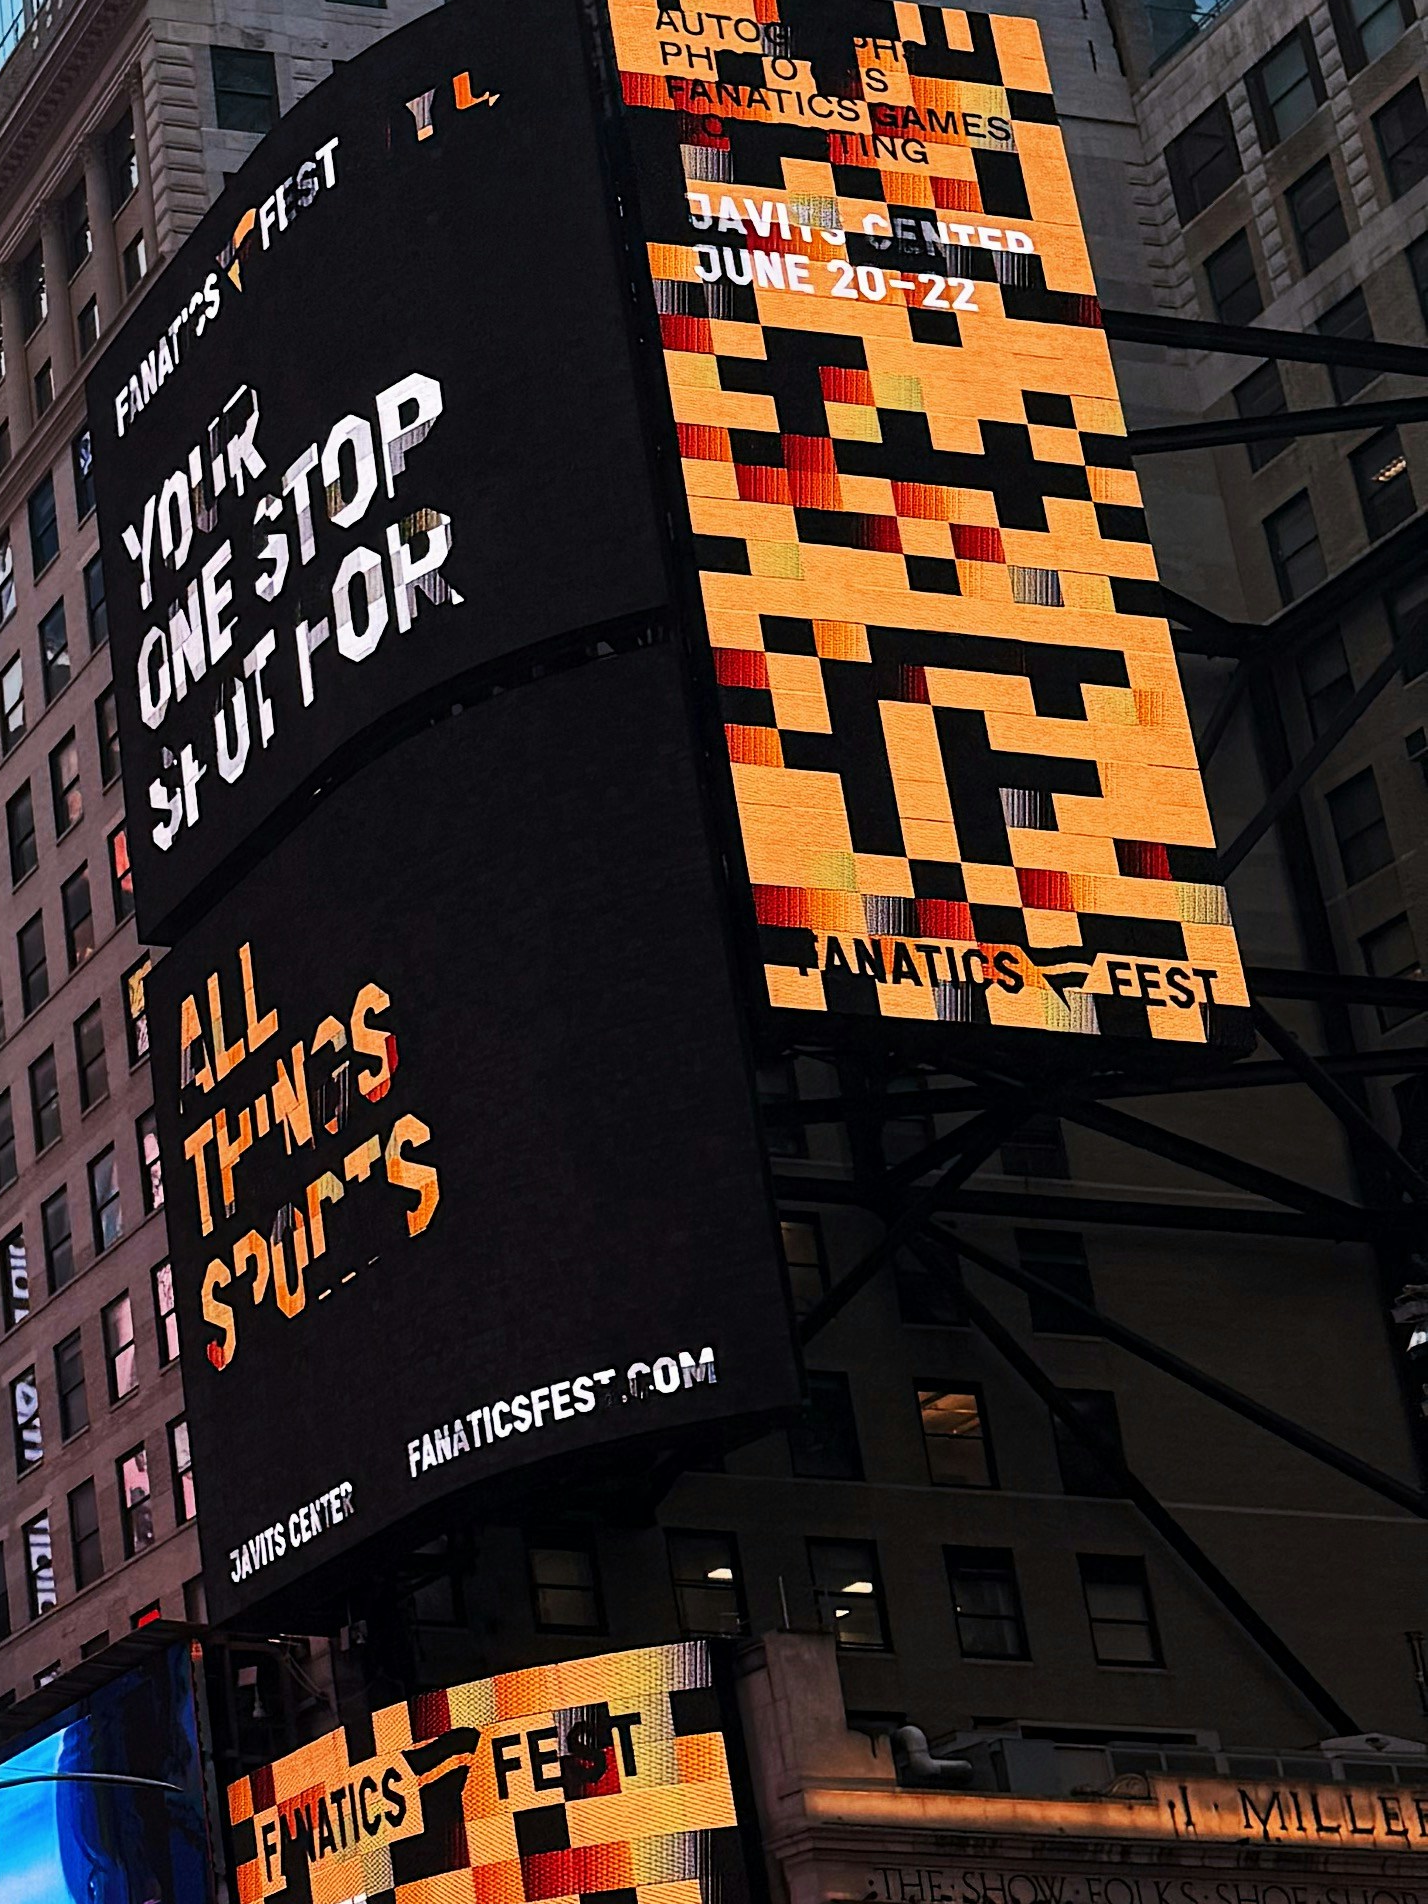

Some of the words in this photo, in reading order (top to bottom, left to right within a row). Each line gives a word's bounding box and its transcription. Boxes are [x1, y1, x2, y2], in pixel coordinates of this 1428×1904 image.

[666, 75, 861, 123] FANATICS
[873, 103, 1013, 142] GAMES
[258, 137, 341, 252] FEST
[691, 243, 815, 295] JUNE
[136, 541, 234, 731] ONE
[254, 372, 444, 604] STOP
[799, 930, 1026, 998] FANATICS
[1106, 958, 1221, 1013] FEST
[180, 942, 278, 1115] ALL
[229, 1521, 287, 1583] JAVITS
[288, 1482, 356, 1551] CENTER
[258, 1768, 408, 1890] FANATICS
[491, 1712, 642, 1800] FEST
[879, 1868, 946, 1902] THE
